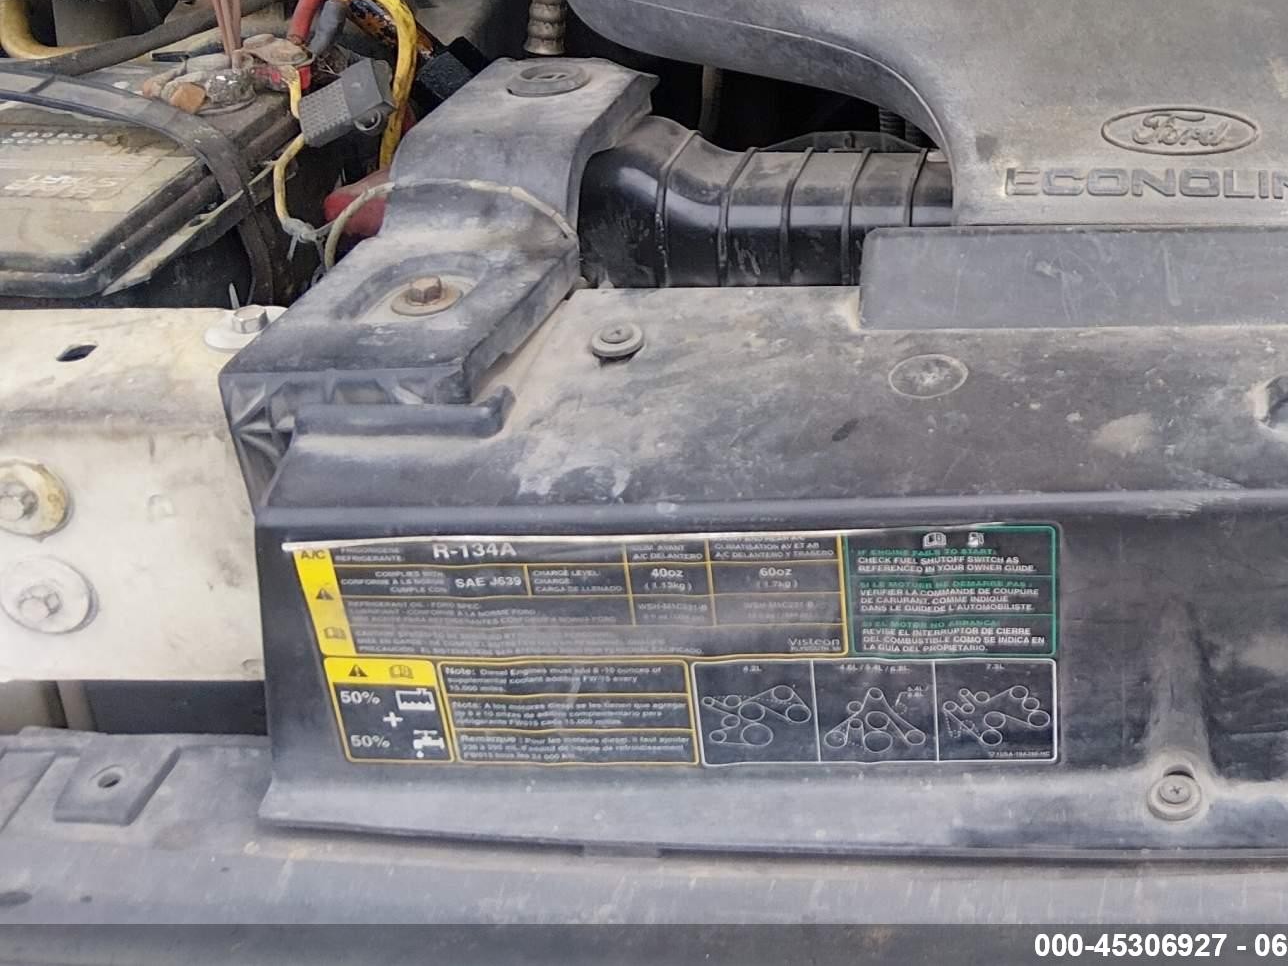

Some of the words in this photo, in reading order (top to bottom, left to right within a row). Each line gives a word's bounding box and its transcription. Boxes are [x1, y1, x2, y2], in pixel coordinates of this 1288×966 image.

[1131, 113, 1230, 147] Ford
[300, 548, 326, 560] A/C
[431, 542, 517, 559] R-134A
[893, 557, 919, 565] FUEL
[920, 556, 965, 565] SHUTOFF
[967, 556, 1005, 564] SWITCH
[1006, 556, 1020, 564] AS
[651, 568, 685, 579] 40oz
[759, 568, 793, 578] 60oz
[857, 565, 923, 574] REFERENCED
[936, 564, 965, 572] YOUR
[966, 564, 1003, 572] OWNER
[454, 578, 487, 588] SAE
[489, 576, 522, 586] J639
[920, 588, 976, 597] COMMANDE
[992, 588, 1040, 596] COUPURE
[860, 596, 874, 604] DE
[932, 596, 968, 605] COMME
[912, 628, 979, 636] INTERRUPTOR
[788, 638, 841, 646] Visteon
[883, 636, 949, 644] COMBUSTIBLE
[953, 636, 982, 644] COMO
[984, 636, 997, 644] SE
[998, 636, 1030, 644] INDICA
[1031, 636, 1045, 644] EN
[902, 644, 920, 652] DEL
[445, 666, 476, 676] Note:
[340, 690, 381, 705] 50%
[350, 734, 391, 748] 50%
